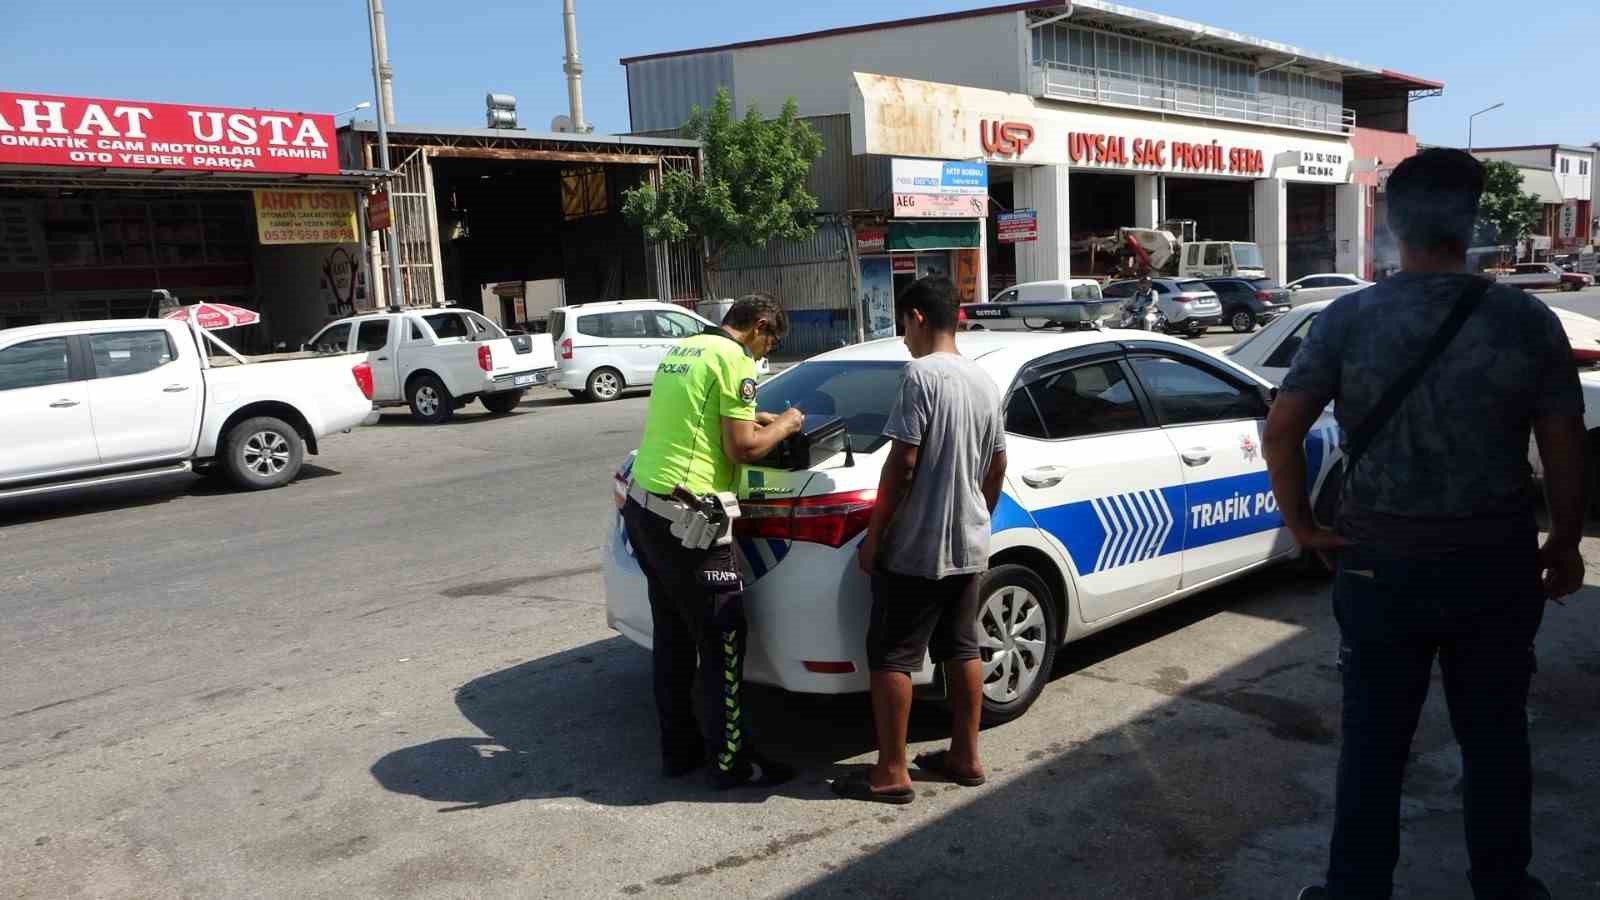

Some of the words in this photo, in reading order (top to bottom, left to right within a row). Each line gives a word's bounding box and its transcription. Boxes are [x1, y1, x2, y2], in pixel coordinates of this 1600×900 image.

[188, 110, 329, 148] USTA
[980, 119, 1035, 156] USP
[97, 139, 144, 152] CAM
[151, 142, 261, 157] MOTORLARI
[267, 146, 328, 160] TAMİRİ
[1067, 131, 1128, 166] UYSAL
[1132, 138, 1166, 169] SAC
[1171, 139, 1225, 173] PROFİL
[1229, 147, 1265, 174] SERA
[70, 151, 112, 163] OTO
[120, 153, 185, 166] YEDEK
[193, 156, 256, 170] PARÇA
[261, 192, 302, 209] AHAT
[311, 192, 351, 210] USTA
[896, 195, 915, 207] AEG
[264, 230, 295, 241] 0532
[1191, 492, 1252, 529] TRAFİK
[1254, 490, 1280, 516] PO
